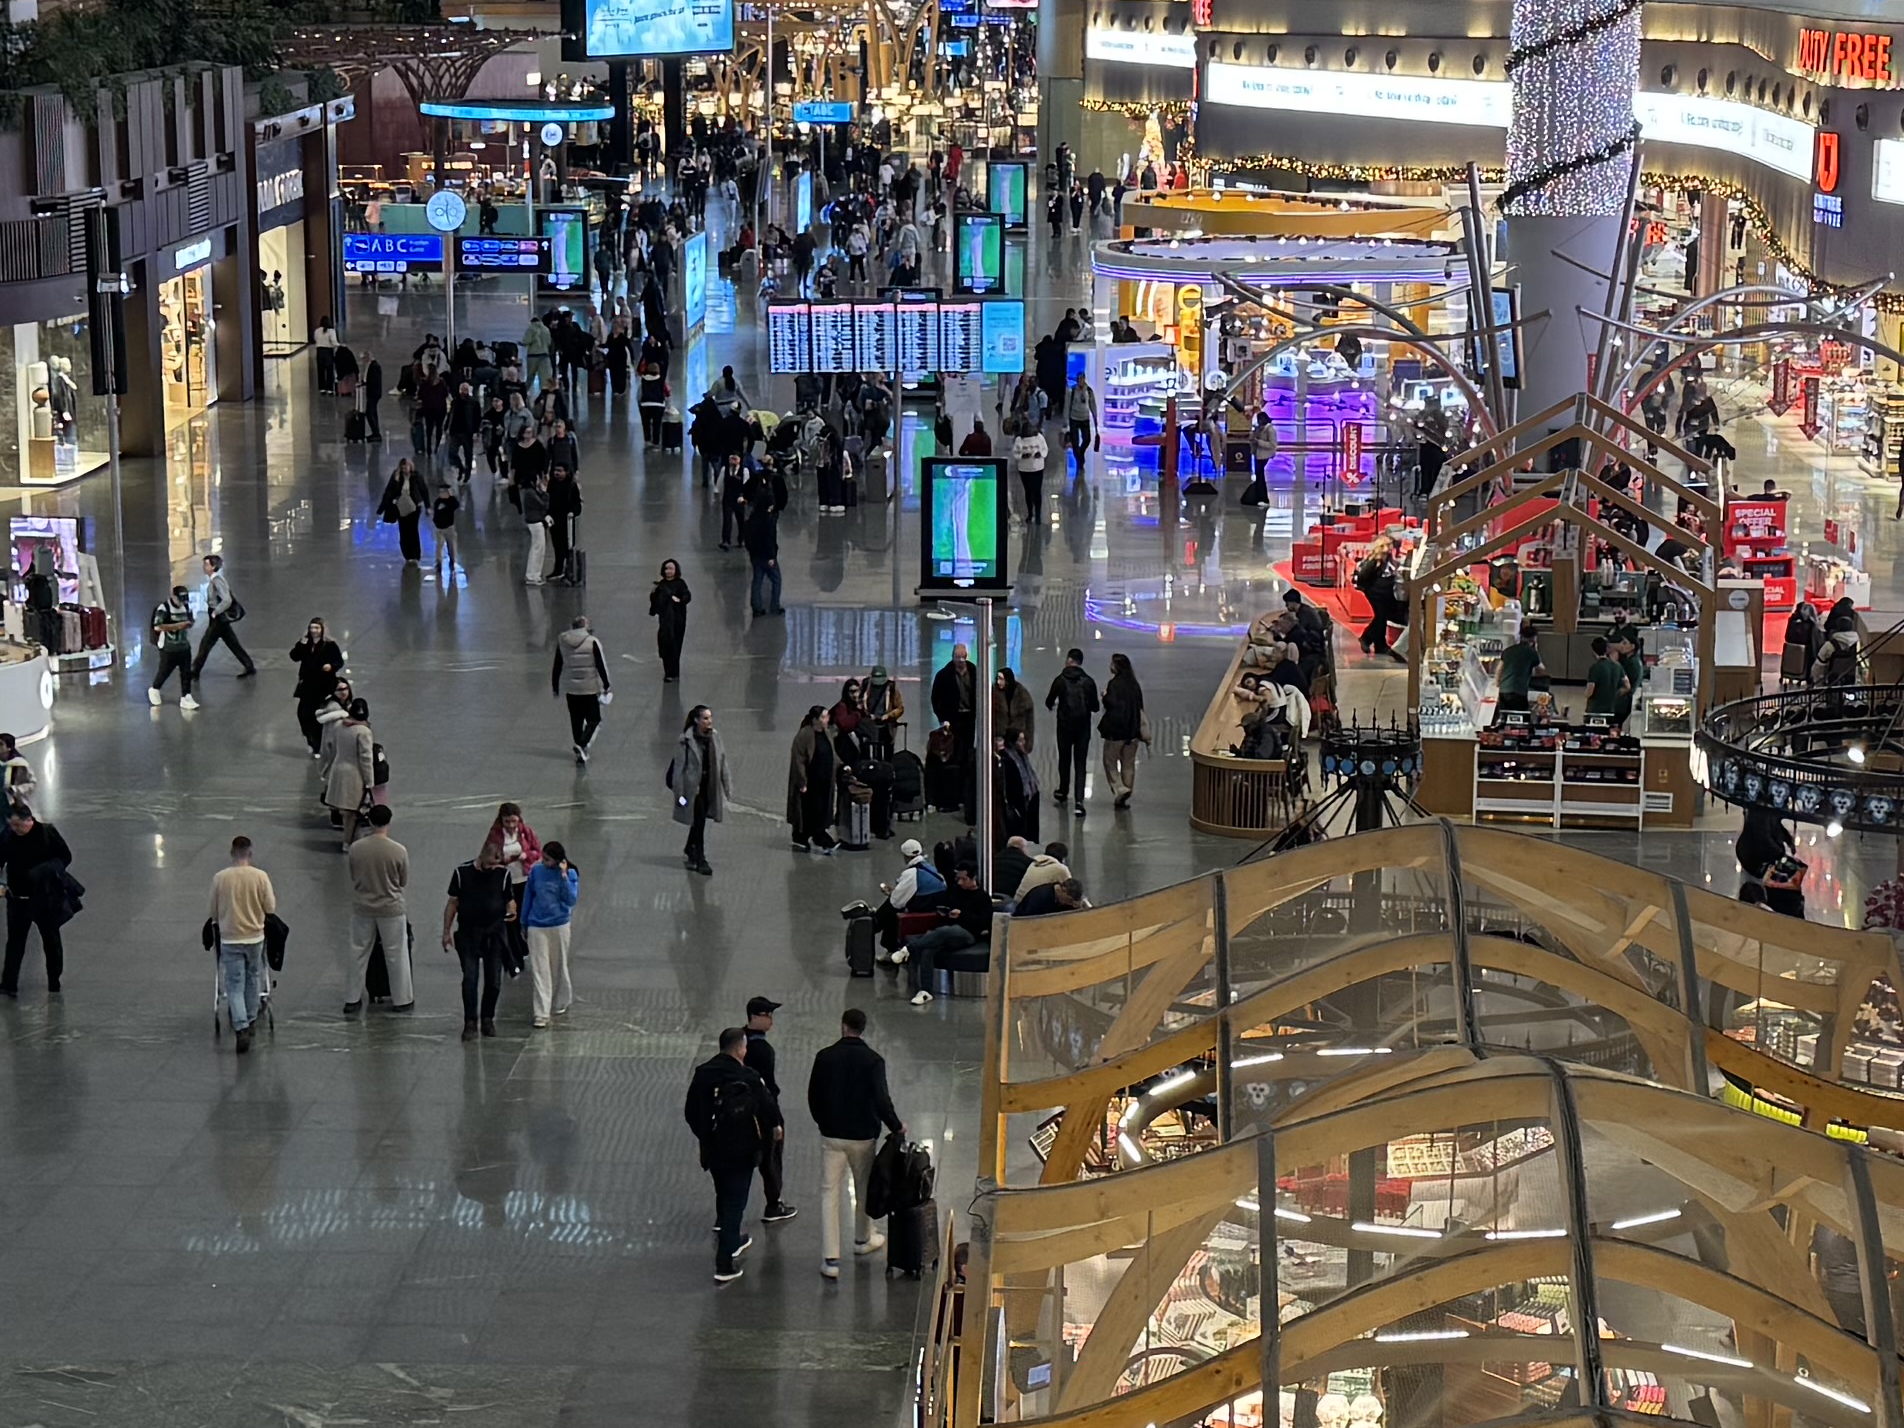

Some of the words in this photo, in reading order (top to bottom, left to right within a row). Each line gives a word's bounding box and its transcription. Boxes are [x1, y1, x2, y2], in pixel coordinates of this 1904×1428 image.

[1799, 28, 1831, 73] DUTY
[1833, 32, 1893, 81] FREE
[1735, 508, 1776, 518] SPECIAL
